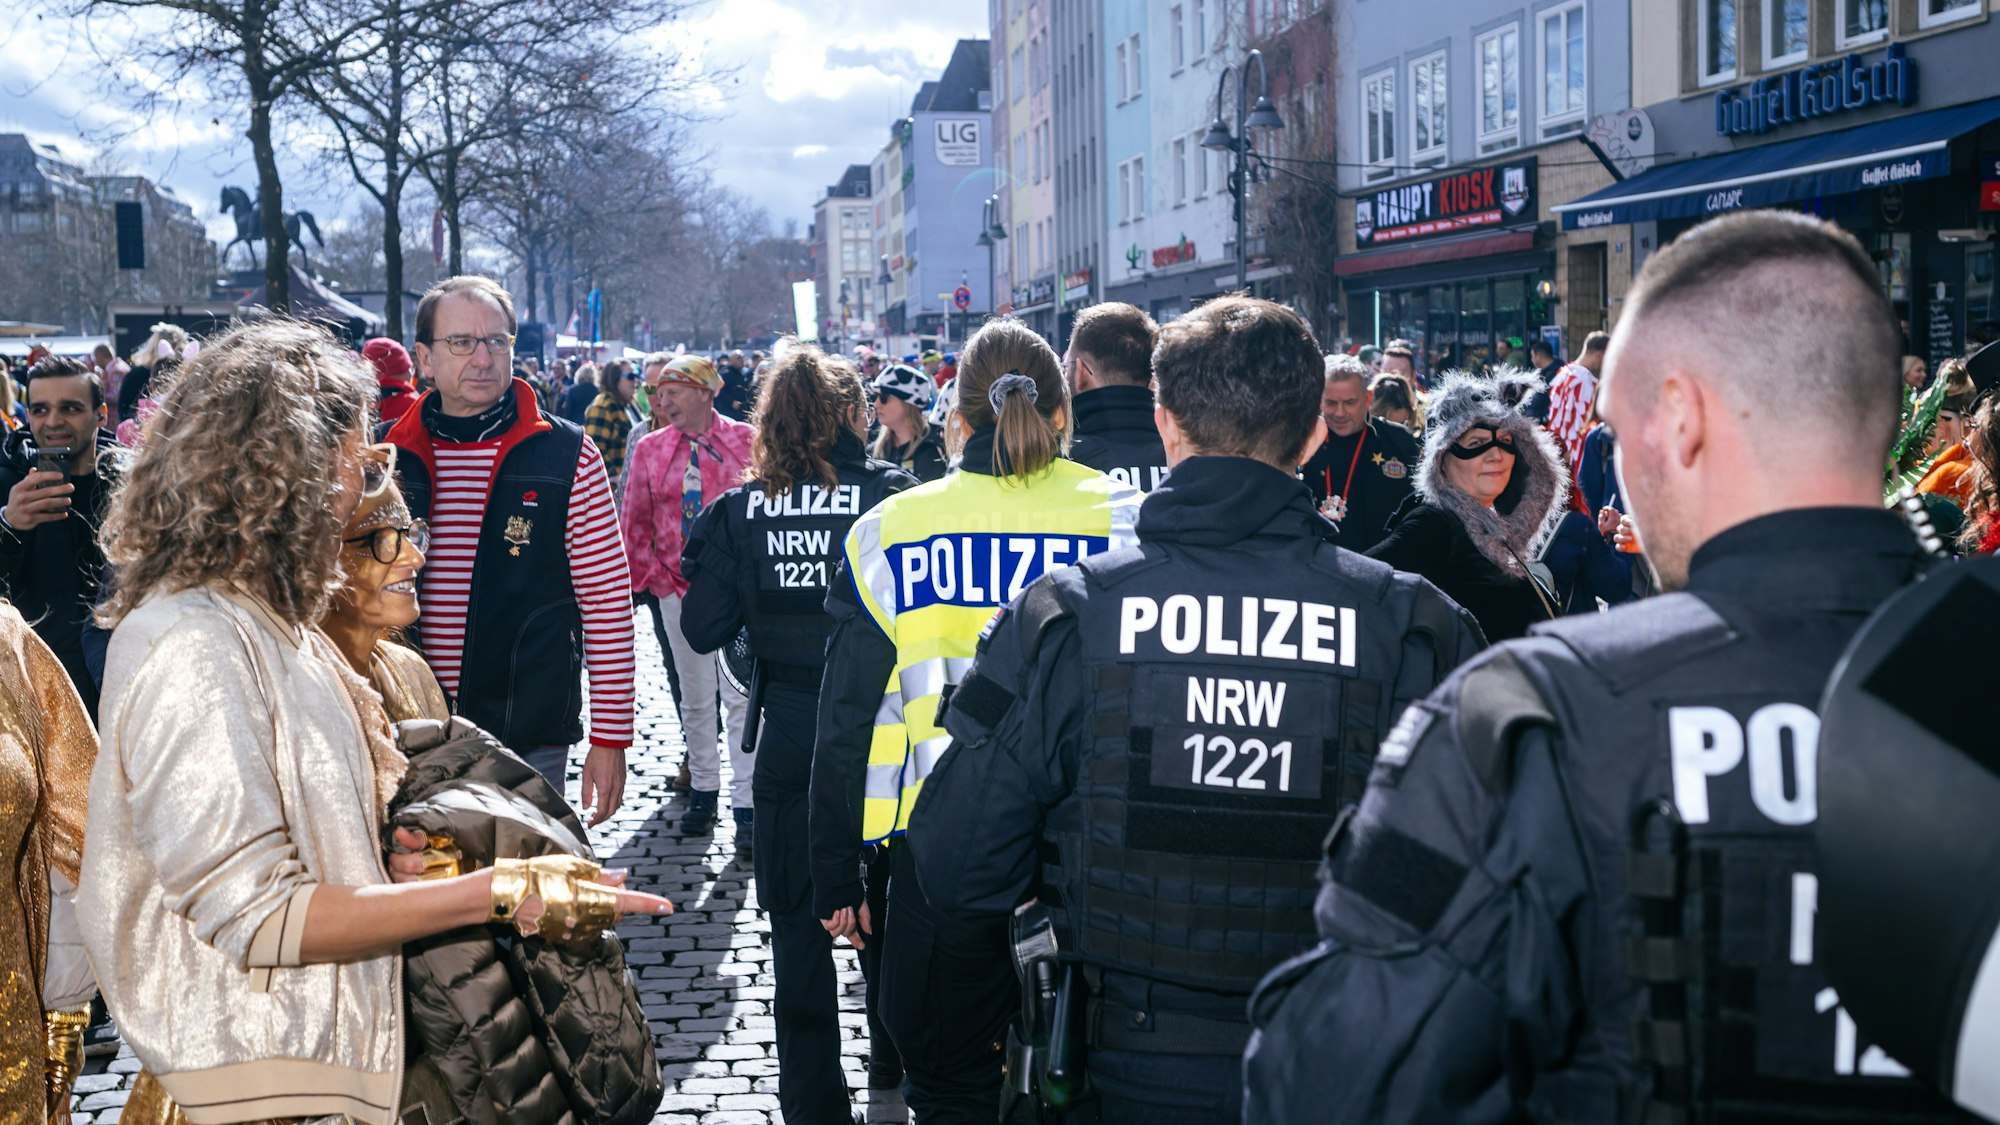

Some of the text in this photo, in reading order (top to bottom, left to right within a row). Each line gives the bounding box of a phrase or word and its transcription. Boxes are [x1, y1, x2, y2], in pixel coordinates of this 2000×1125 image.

[938, 123, 976, 143] LIG
[1377, 169, 1495, 227] HAUPT KIOSK
[746, 485, 861, 519] POLIZEI
[766, 530, 832, 556] NRW
[774, 561, 827, 588] 1221
[1119, 594, 1357, 667] POLIZEI
[1186, 676, 1287, 728] NRW
[1184, 733, 1293, 791] 1221
